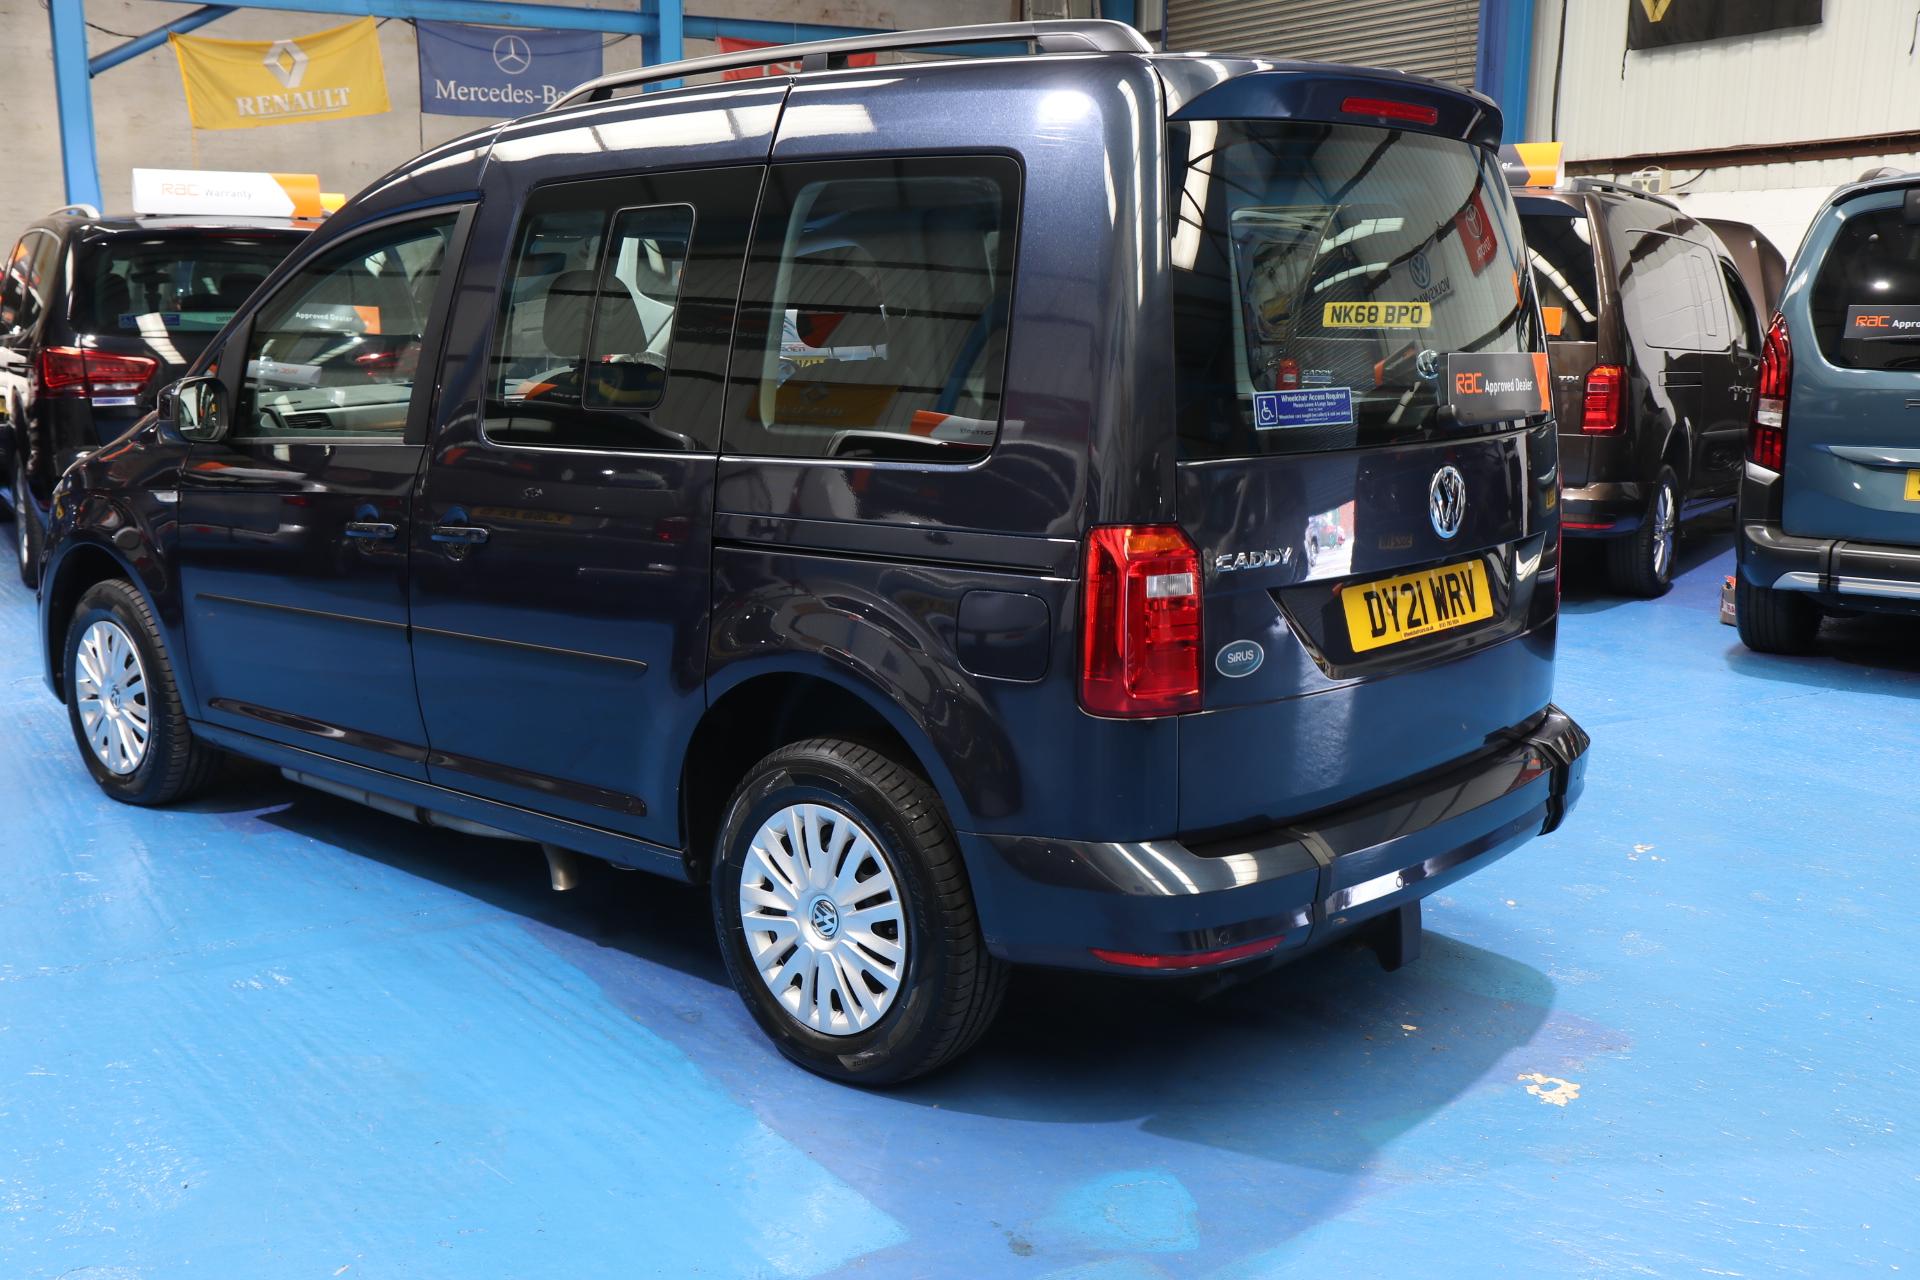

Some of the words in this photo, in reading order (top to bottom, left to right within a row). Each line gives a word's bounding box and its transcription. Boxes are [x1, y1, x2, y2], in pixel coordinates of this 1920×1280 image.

[435, 79, 569, 104] Mercedes-Be
[235, 87, 350, 116] RENAULT
[204, 188, 252, 199] Warranty
[296, 312, 327, 321] Approved
[329, 313, 353, 322] Dealer
[1331, 305, 1378, 323] NK68
[1892, 319, 1920, 329] Appro
[1485, 378, 1515, 396] Approved
[1515, 378, 1533, 392] Dealer
[1281, 394, 1308, 403] Wheelchair
[1309, 393, 1325, 401] Access
[1326, 391, 1346, 401] Required
[1216, 547, 1293, 572] CADDY
[1363, 580, 1429, 638] DY21
[1428, 569, 1477, 621] WRV
